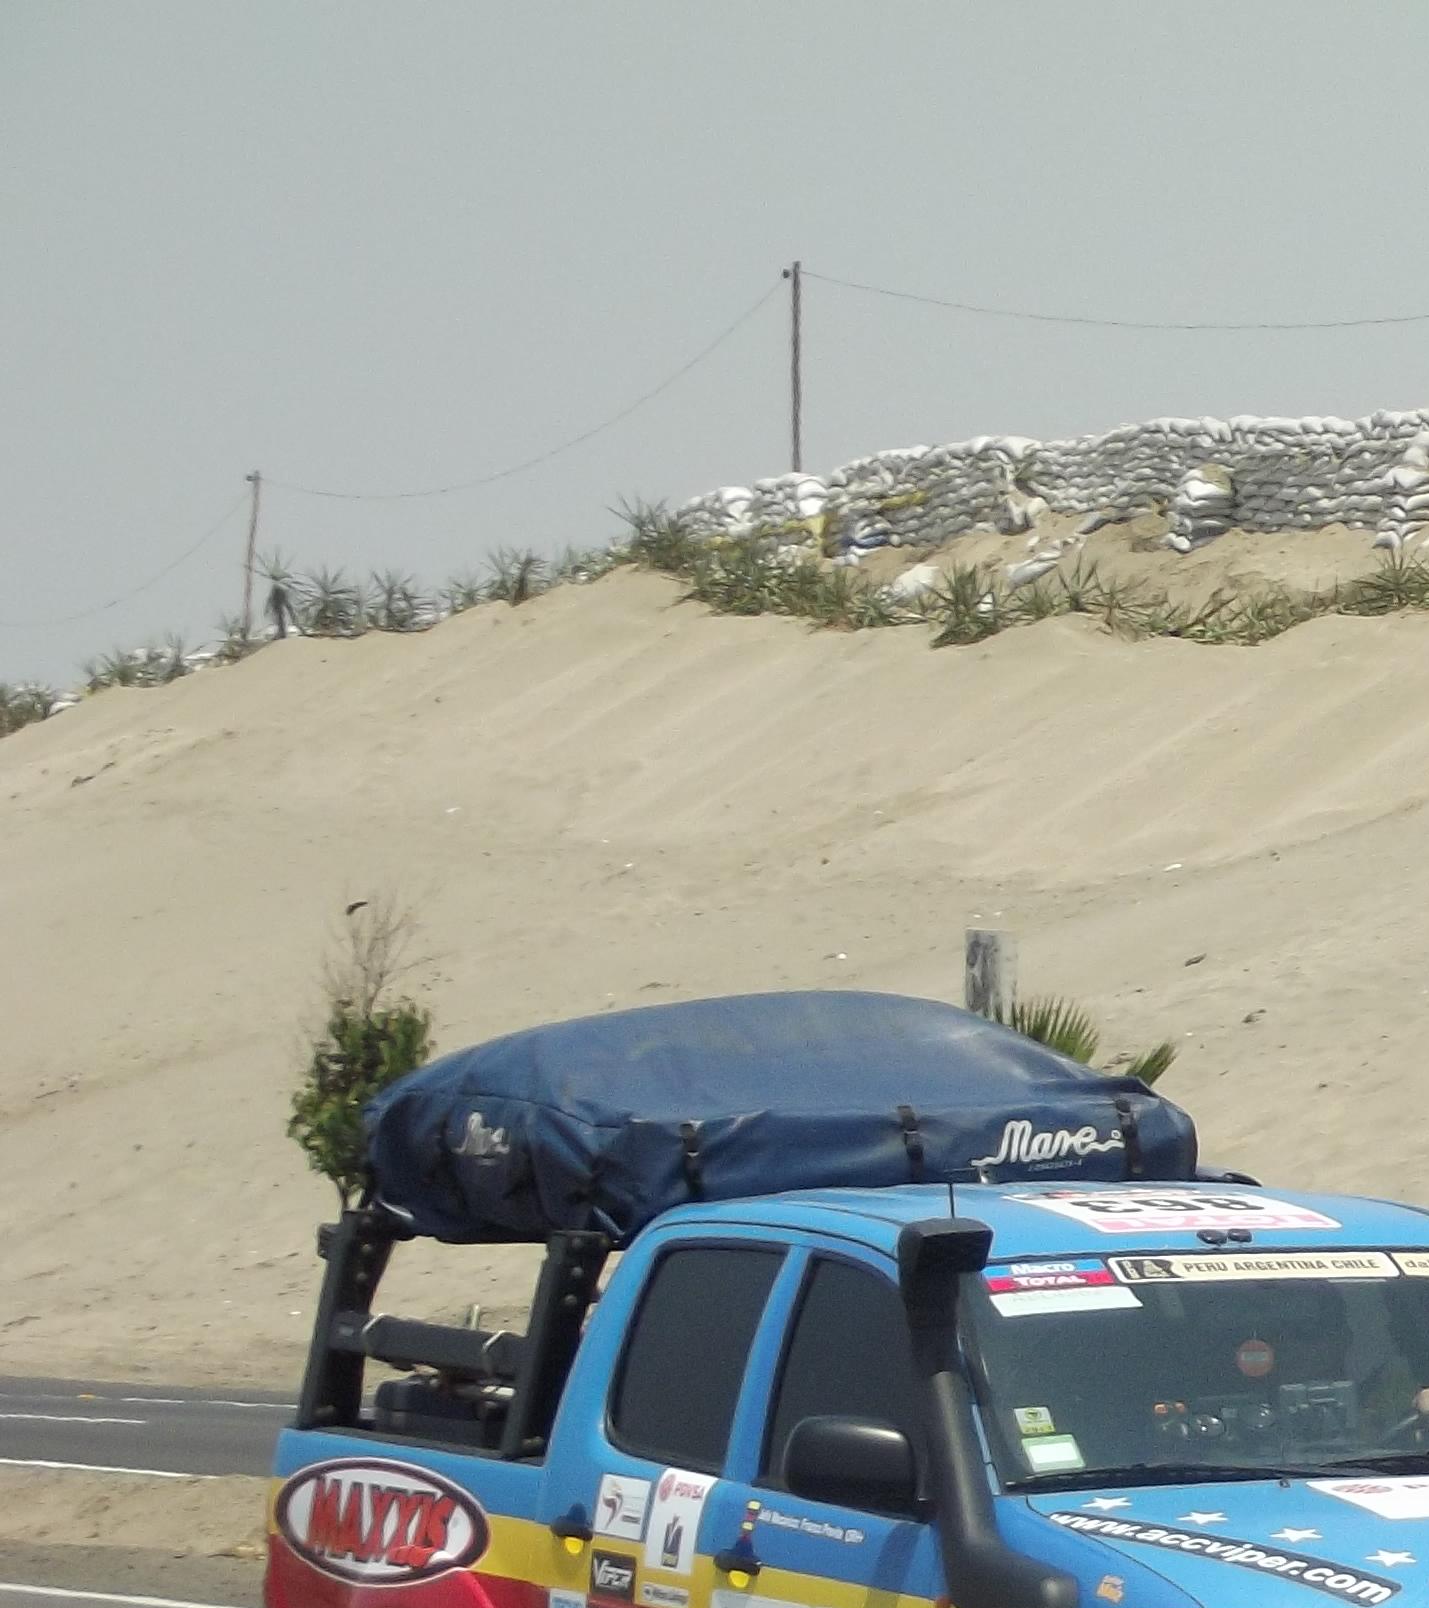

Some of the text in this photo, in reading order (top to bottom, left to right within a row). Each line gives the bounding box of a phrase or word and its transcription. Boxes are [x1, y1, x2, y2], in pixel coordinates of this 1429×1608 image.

[1009, 1262, 1076, 1276] Macro
[1234, 1259, 1327, 1272] ARGENTINA
[1330, 1258, 1381, 1270] CHILE
[303, 1477, 458, 1569] MAXXIS
[1049, 1511, 1393, 1606] www.accviper.com
